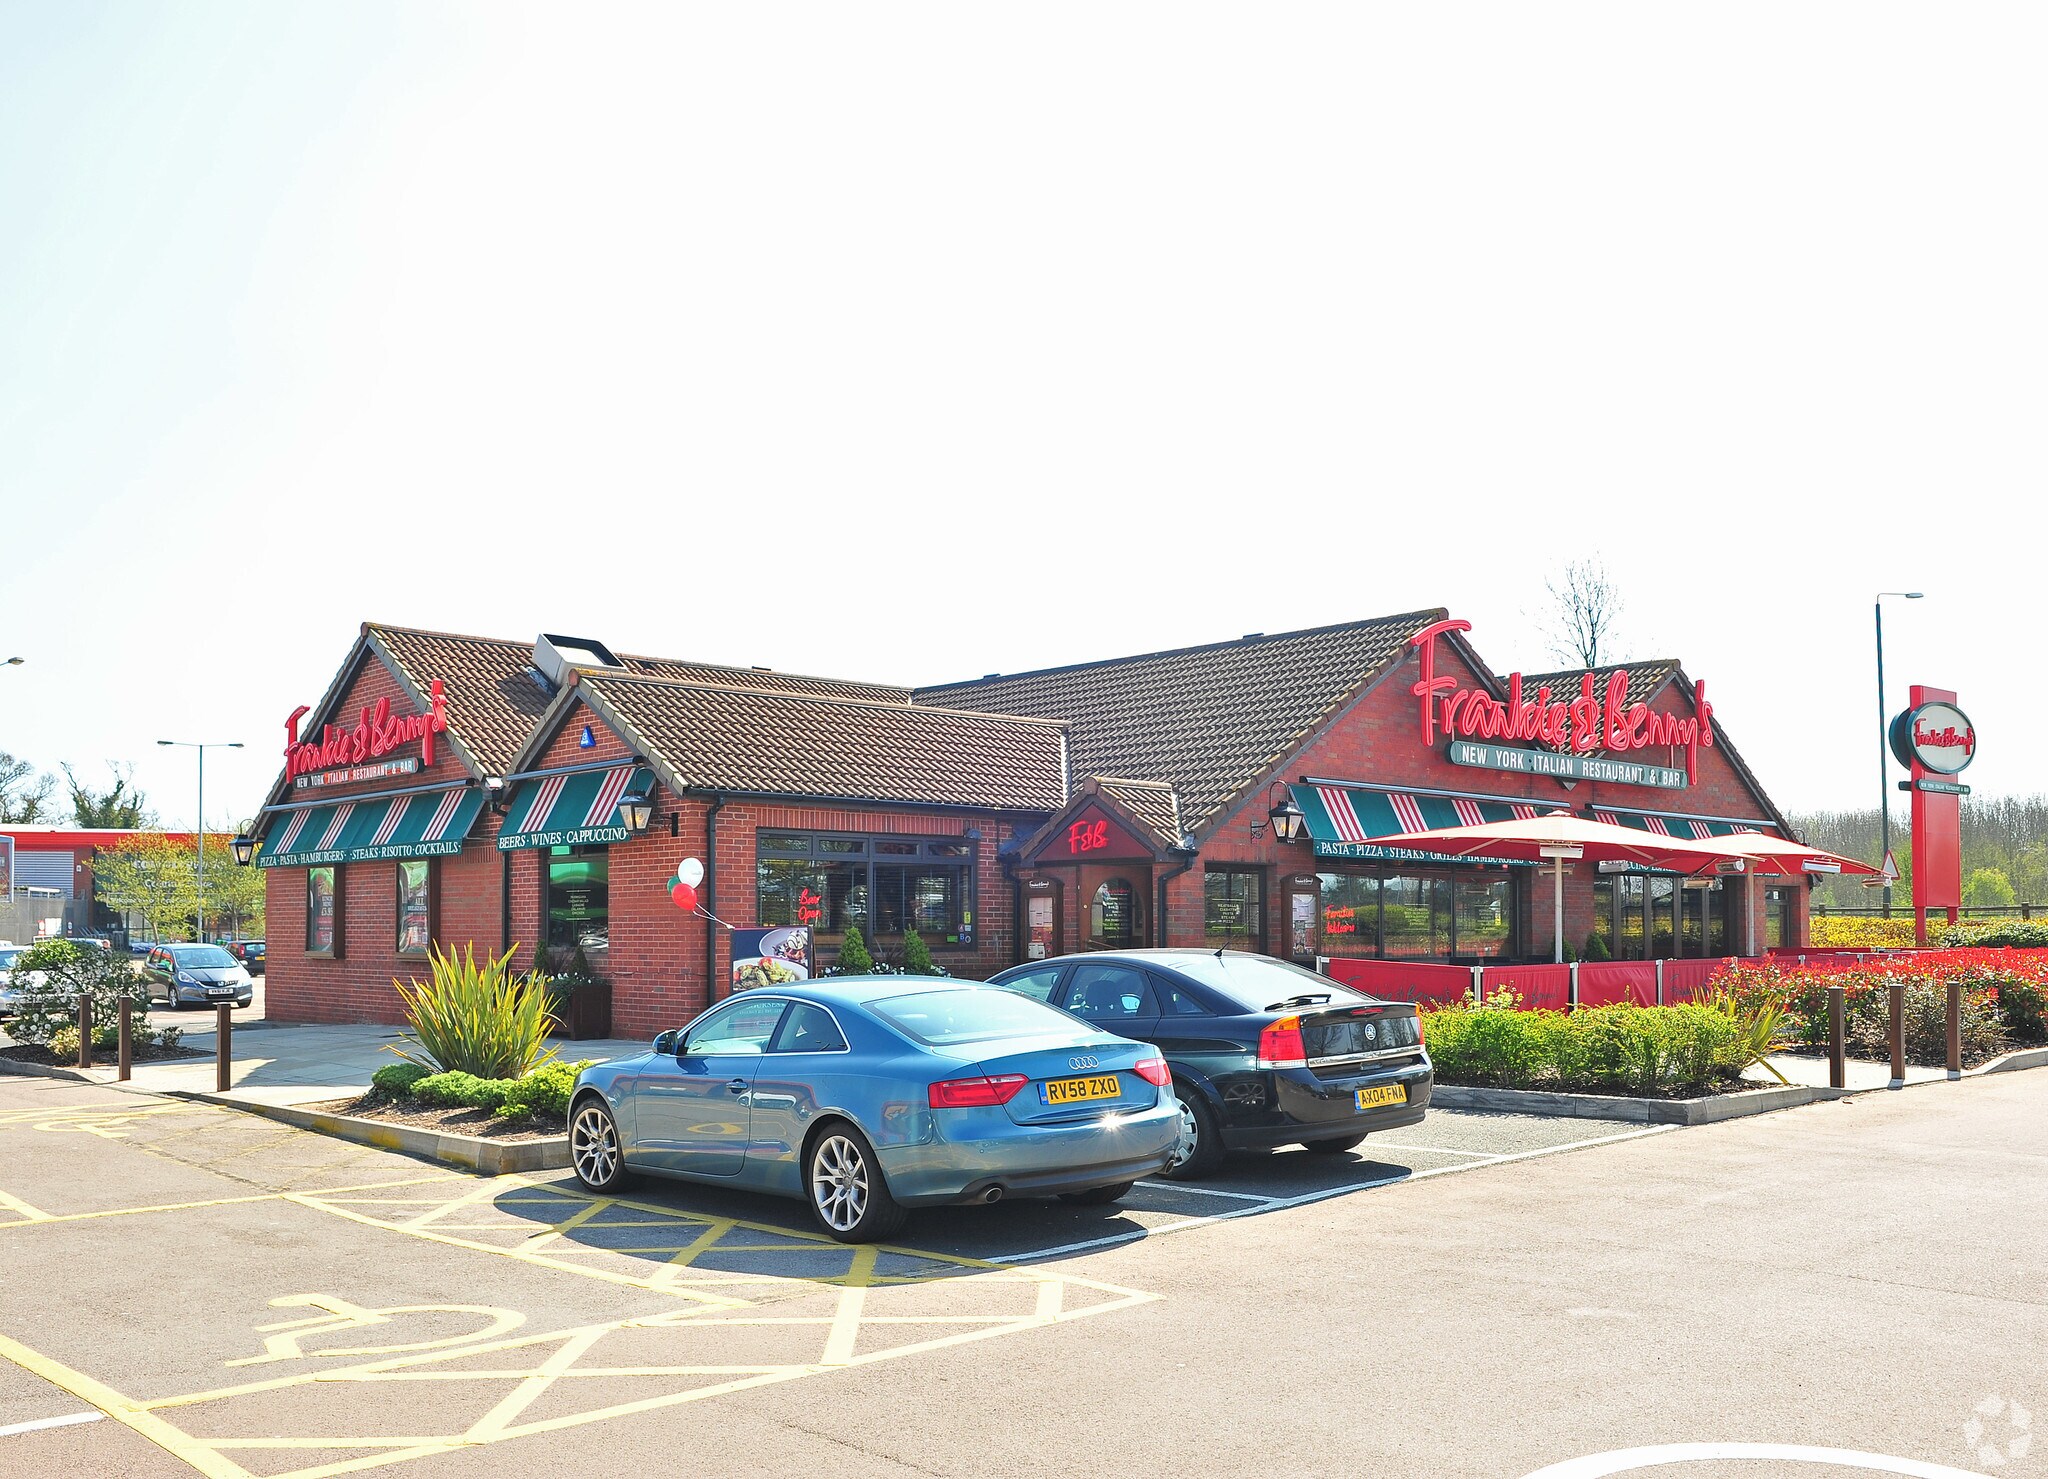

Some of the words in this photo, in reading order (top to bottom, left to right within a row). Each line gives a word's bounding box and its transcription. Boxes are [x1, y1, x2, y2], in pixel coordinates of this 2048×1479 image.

[1410, 619, 1568, 746] Frankie
[1570, 672, 1600, 752] &
[1603, 669, 1714, 785] Benny's
[284, 705, 349, 783] Frankie
[352, 706, 372, 763] &
[371, 678, 447, 766] Benny's
[296, 776, 307, 788] NEW
[311, 774, 325, 786] YORK
[327, 770, 348, 783] ITALIAN
[352, 764, 389, 780] RESTAURANT
[391, 763, 397, 775] &
[400, 760, 413, 773] BAR
[1462, 745, 1487, 765] NEW
[1496, 750, 1524, 769] YORK
[1533, 755, 1573, 775] ITALIAN
[1582, 761, 1643, 782] RESTAURANT
[1649, 769, 1657, 782] &
[1663, 771, 1680, 787] BAR
[498, 835, 526, 849] BEERS
[531, 831, 562, 846] WINES
[566, 827, 627, 844] CAPPUCCINO
[260, 856, 277, 867] PIZZA
[279, 853, 298, 865] PASTA
[300, 849, 344, 863] HAMBURGERS
[352, 846, 379, 860] STEAKS
[381, 844, 412, 858] RISOTTO
[415, 841, 459, 856] COCKTAILS
[1321, 842, 1350, 856] PASTA
[1356, 844, 1385, 857] PIZZA
[1390, 847, 1425, 860] STEAKS
[799, 887, 821, 905] Bar
[798, 906, 822, 925] Open
[1048, 1080, 1087, 1100] RV58
[1089, 1077, 1118, 1096] ZXO
[1361, 1088, 1386, 1105] AX04
[1386, 1085, 1405, 1101] FNA
